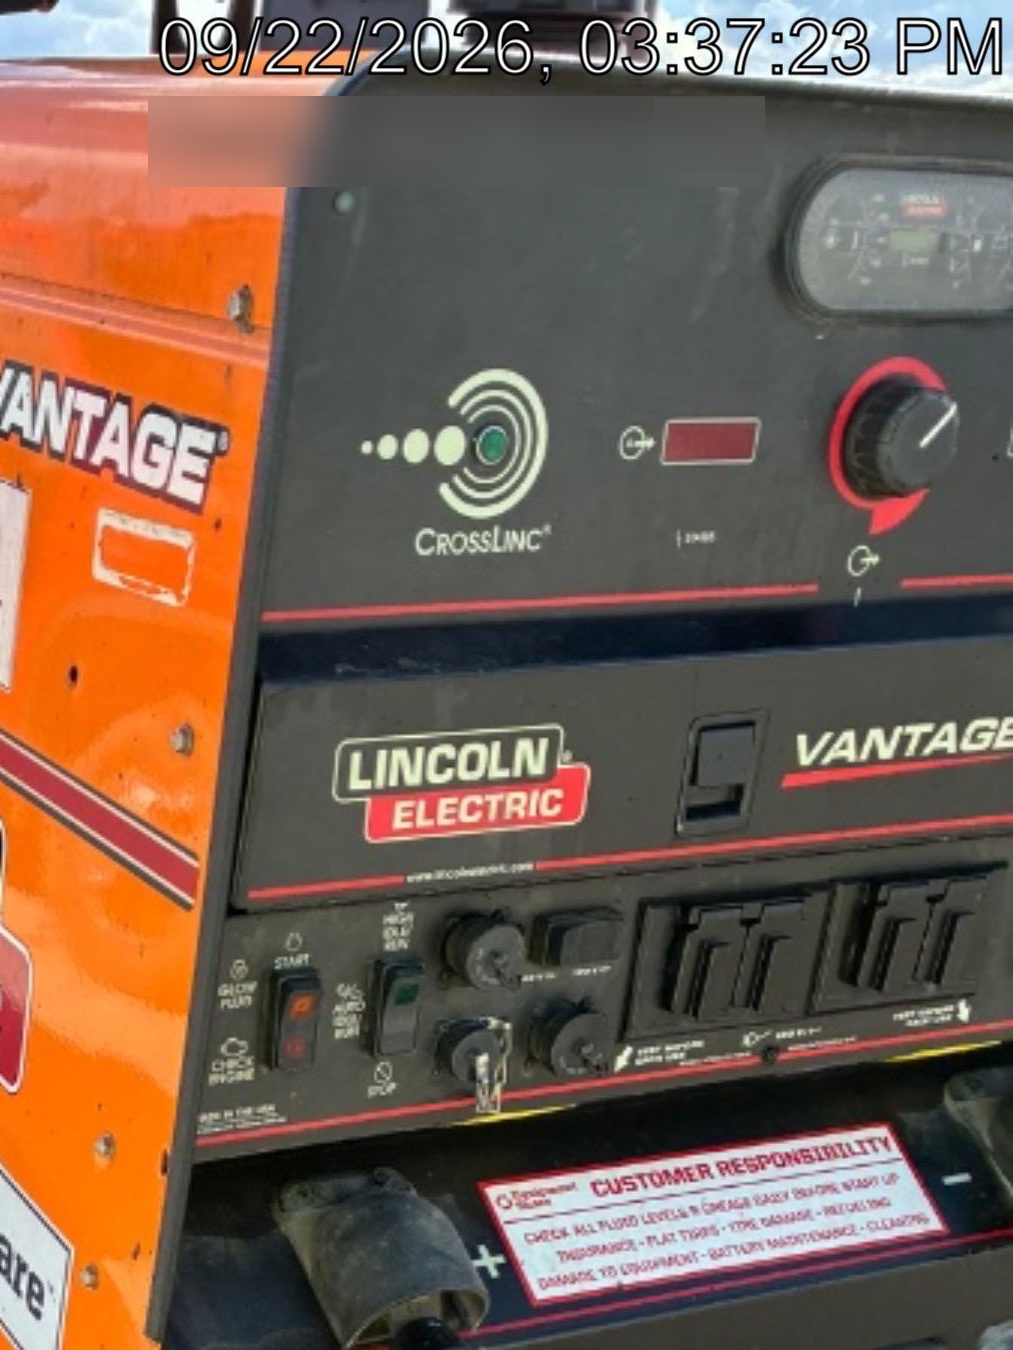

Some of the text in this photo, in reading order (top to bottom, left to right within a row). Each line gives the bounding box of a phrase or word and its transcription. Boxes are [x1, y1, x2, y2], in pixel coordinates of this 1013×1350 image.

[348, 738, 548, 790] LINCOLN
[392, 788, 564, 830] ELECTRIC
[590, 1136, 891, 1197] CUSTOMER RESPONSIBILITY
